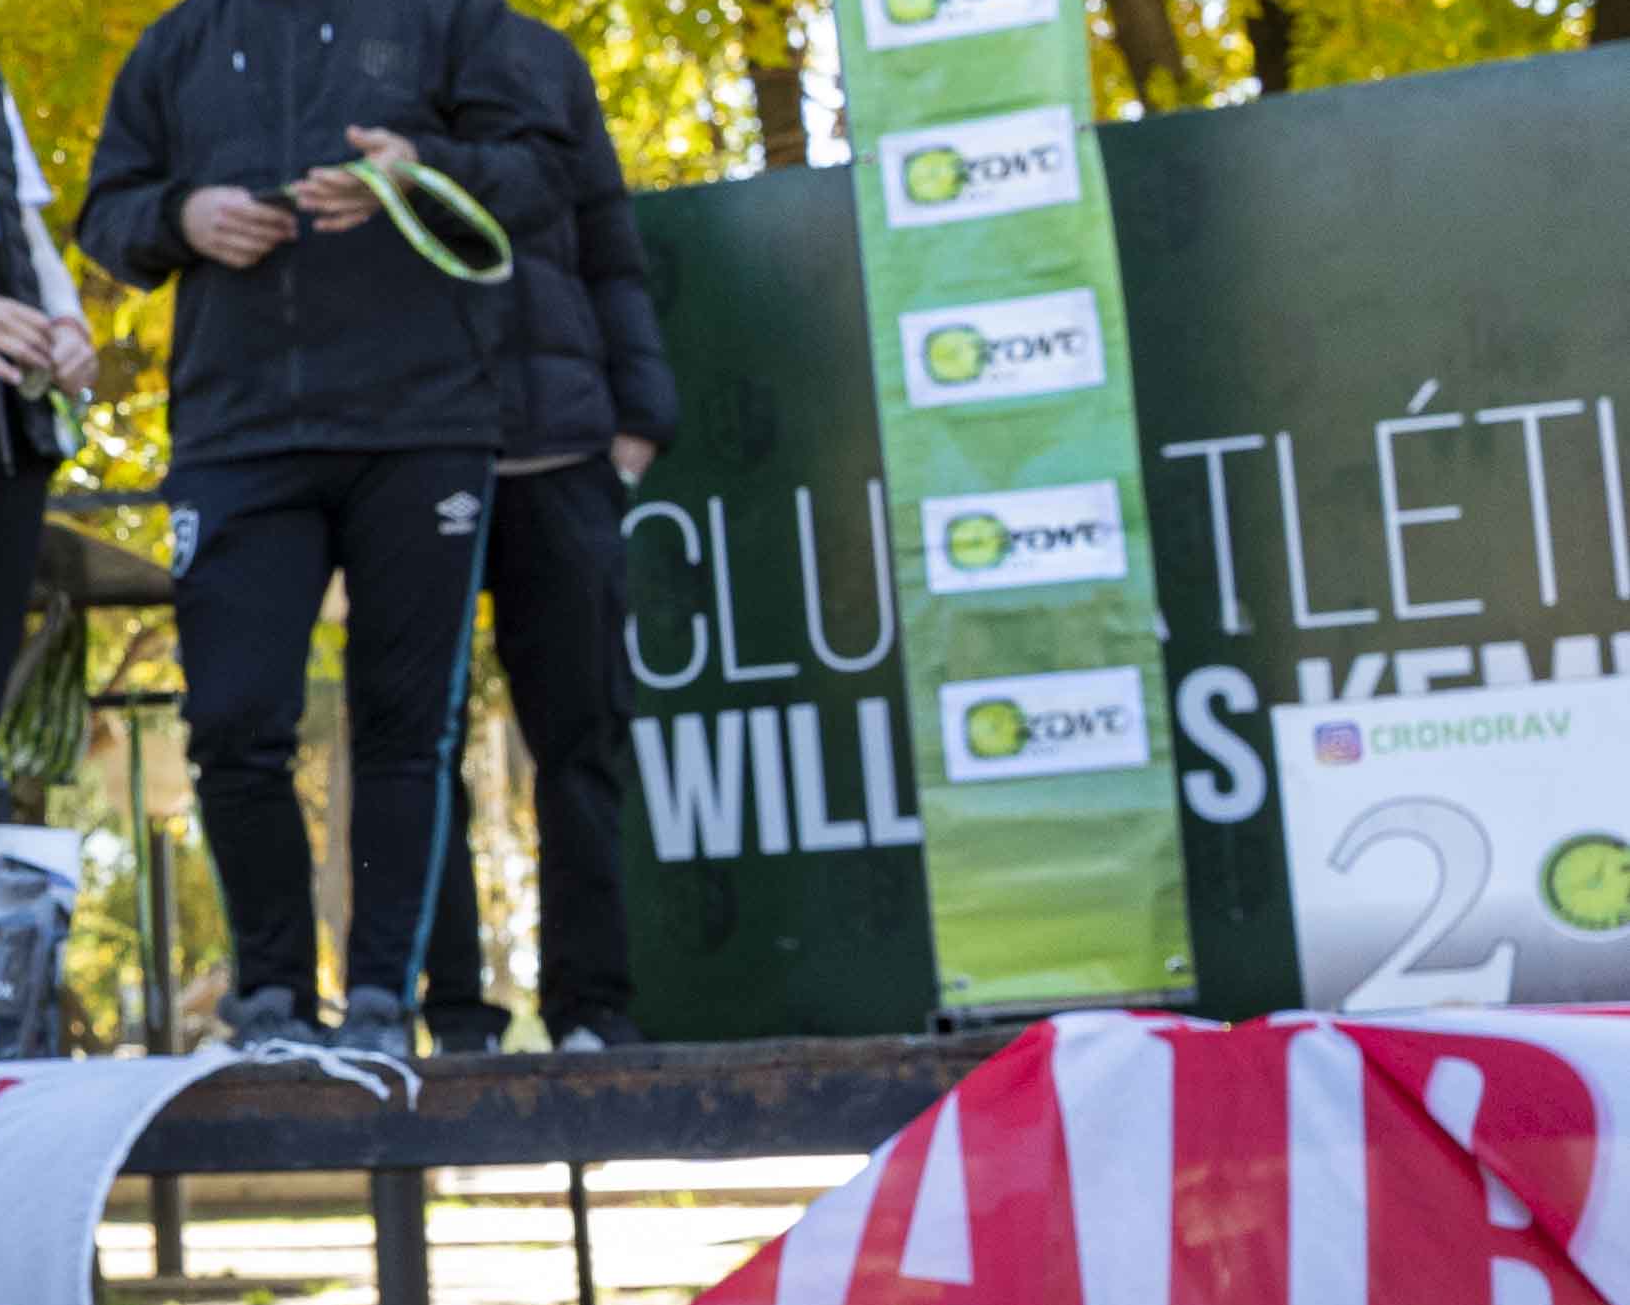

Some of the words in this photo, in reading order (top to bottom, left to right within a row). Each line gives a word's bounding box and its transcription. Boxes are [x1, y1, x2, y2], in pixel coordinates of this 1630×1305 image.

[621, 478, 895, 690] CLU
[1154, 379, 1630, 644] TLÉTI
[1369, 710, 1571, 756] CRONORAV
[1326, 796, 1516, 1012] 2
